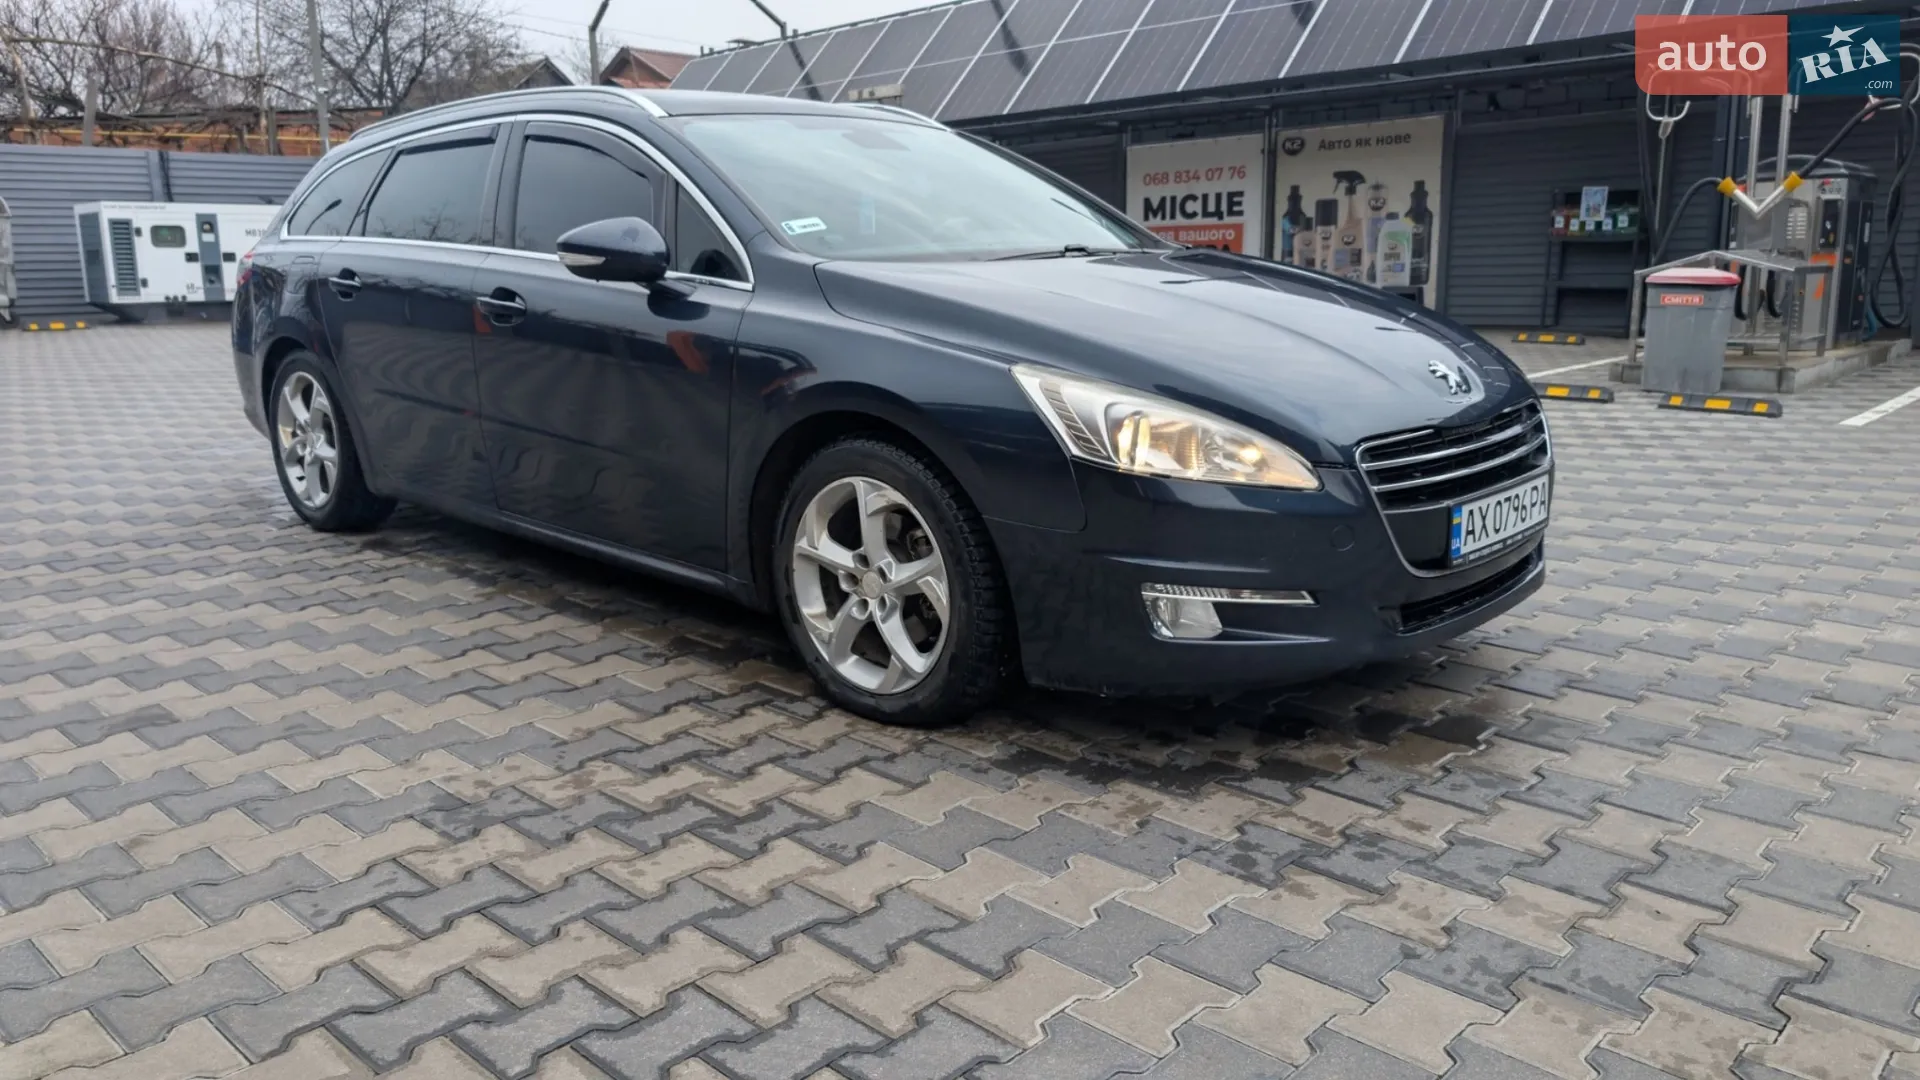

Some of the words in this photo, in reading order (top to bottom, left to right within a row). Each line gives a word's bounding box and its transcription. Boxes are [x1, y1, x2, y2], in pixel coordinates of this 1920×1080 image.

[1318, 139, 1352, 151] Авто
[1355, 136, 1372, 148] як
[1376, 133, 1412, 146] нове
[1143, 171, 1169, 186] 068
[1174, 169, 1200, 184] 834
[1205, 167, 1223, 181] 07
[1228, 165, 1246, 180] 76
[1143, 190, 1244, 221] МІСЦЕ
[1179, 228, 1235, 241] вашого
[1463, 503, 1490, 546] AX
[1493, 489, 1527, 534] 0796
[1530, 482, 1546, 520] PA
[1451, 538, 1460, 550] UA
